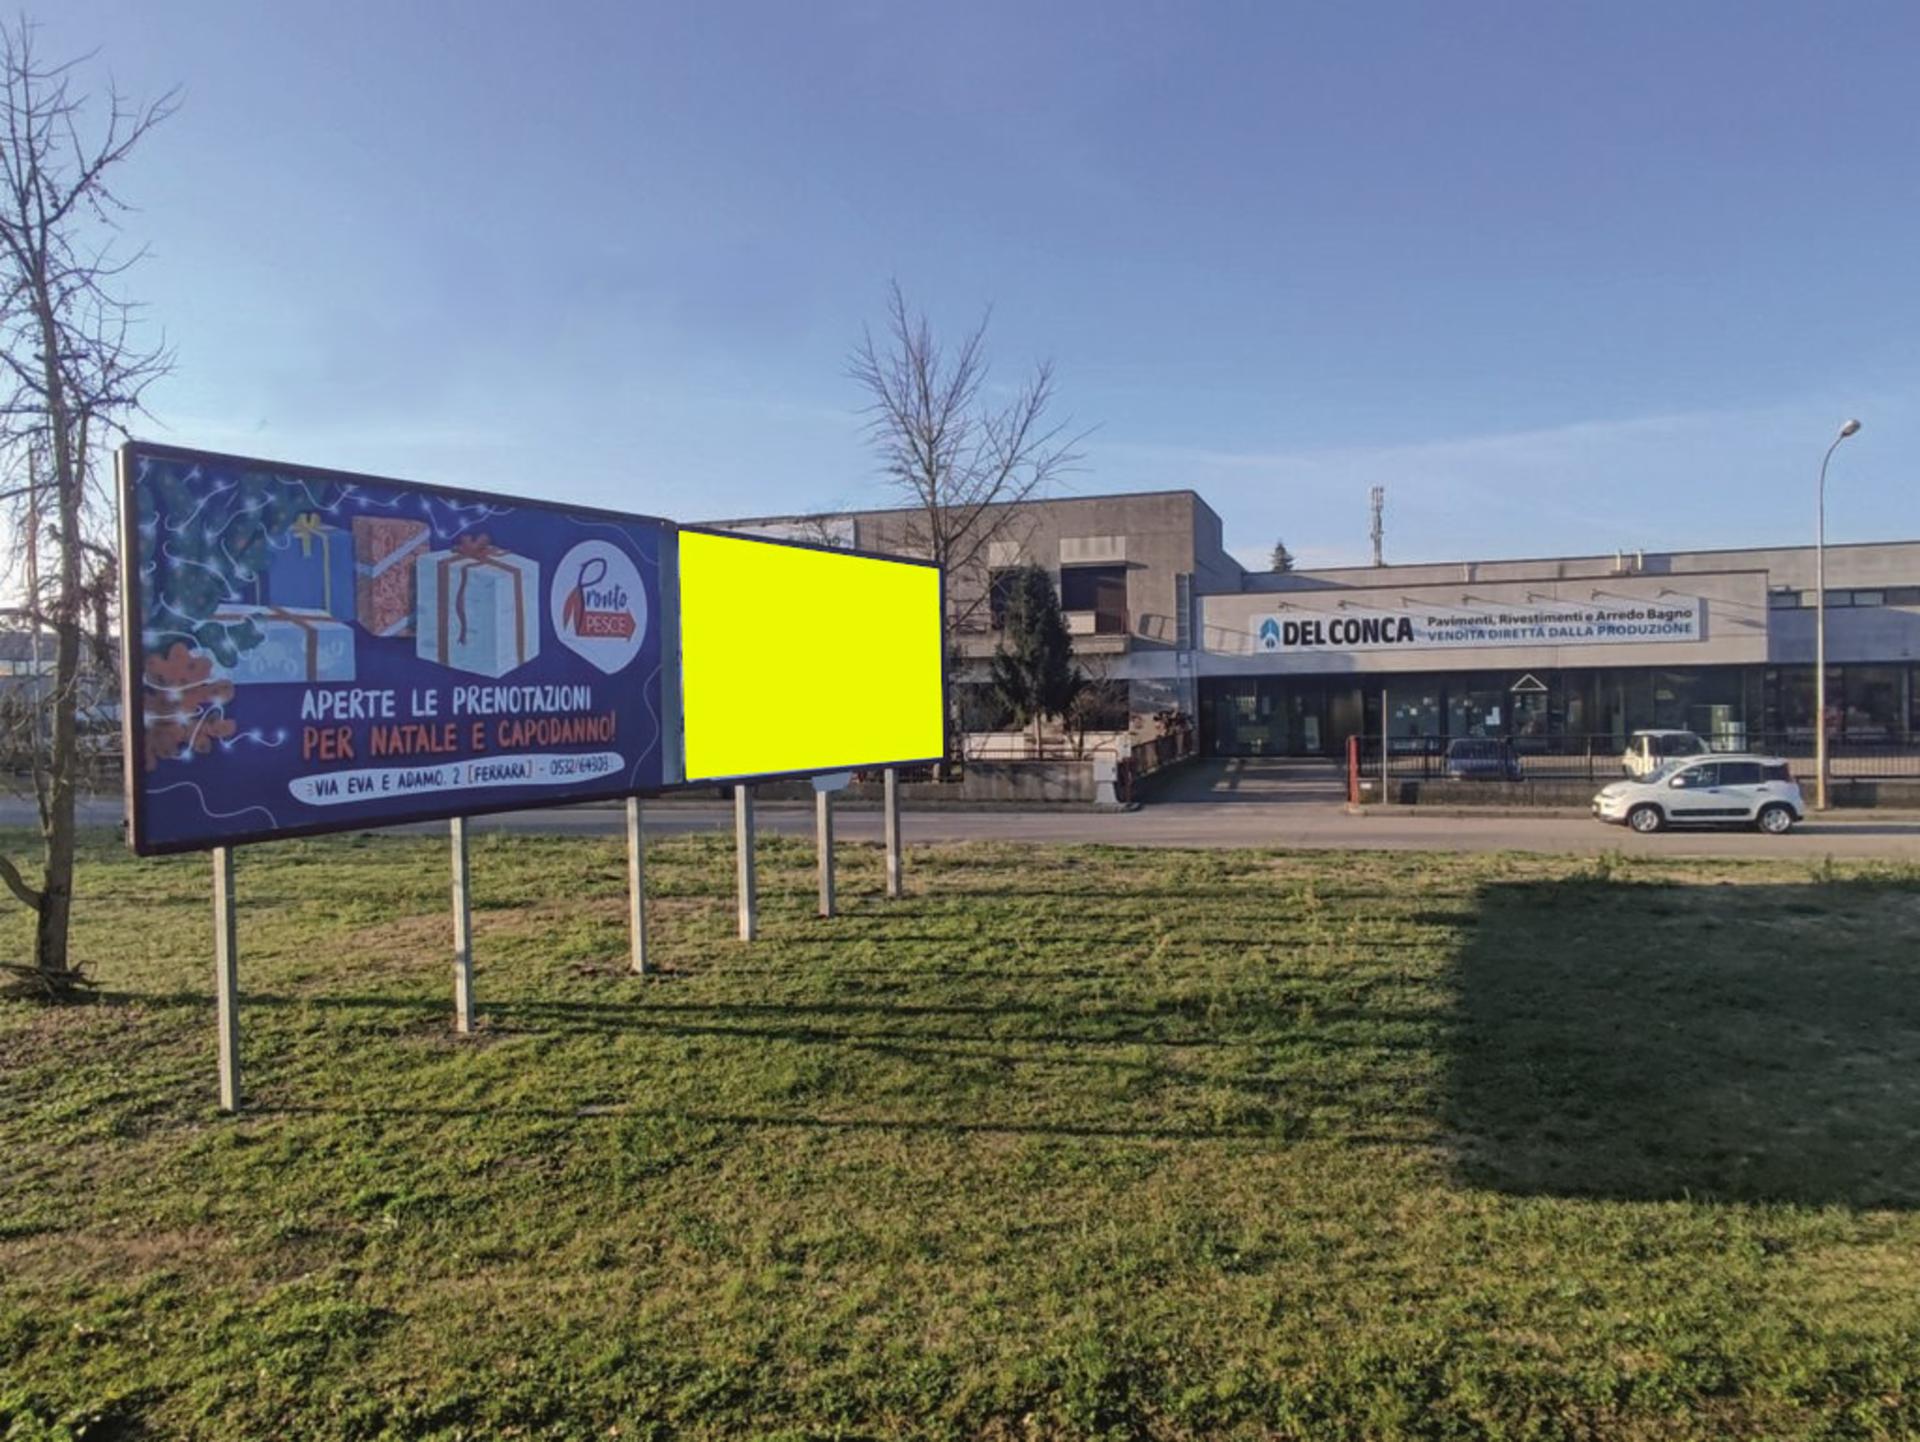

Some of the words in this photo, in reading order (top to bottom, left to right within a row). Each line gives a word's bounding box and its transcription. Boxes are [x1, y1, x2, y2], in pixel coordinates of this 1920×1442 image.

[587, 615, 629, 633] PESCE
[1499, 611, 1583, 625] Rivestimenti
[1585, 613, 1593, 621] e
[1597, 609, 1644, 621] Arredo
[1647, 608, 1693, 621] Bagno
[1428, 629, 1485, 641] VENDITA
[1488, 627, 1545, 640] DIRETTA
[1547, 627, 1593, 638] DALLA
[1597, 623, 1693, 636] PRODUZIONE
[301, 688, 396, 720] APERTE
[411, 689, 438, 717] LE
[452, 685, 592, 715] PRENOTAZIONI
[303, 726, 354, 760] PER
[371, 722, 457, 756] NATALE
[471, 722, 485, 750] E
[499, 710, 616, 747] CAPODANNO!
[315, 779, 338, 797] VIA
[347, 775, 374, 794] EVA
[381, 774, 389, 791] E
[452, 766, 460, 784] 2
